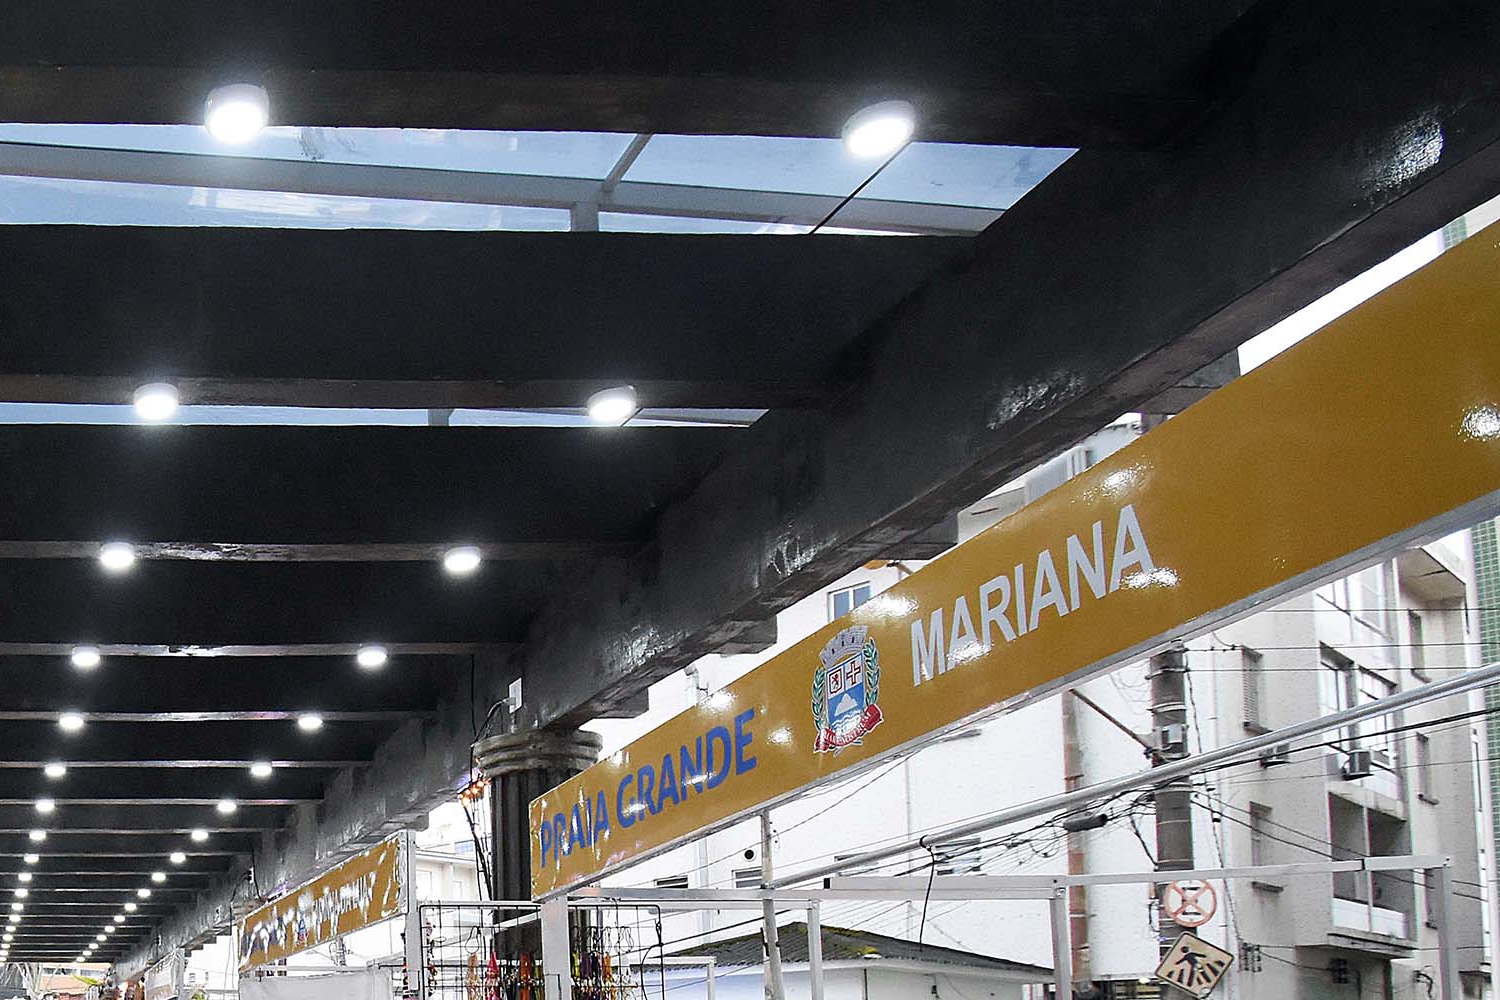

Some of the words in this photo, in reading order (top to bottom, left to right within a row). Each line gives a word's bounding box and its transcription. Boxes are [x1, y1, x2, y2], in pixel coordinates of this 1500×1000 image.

[910, 504, 1155, 688] MARIANA
[541, 791, 610, 868] PRAIA
[616, 707, 758, 828] GRANDE
